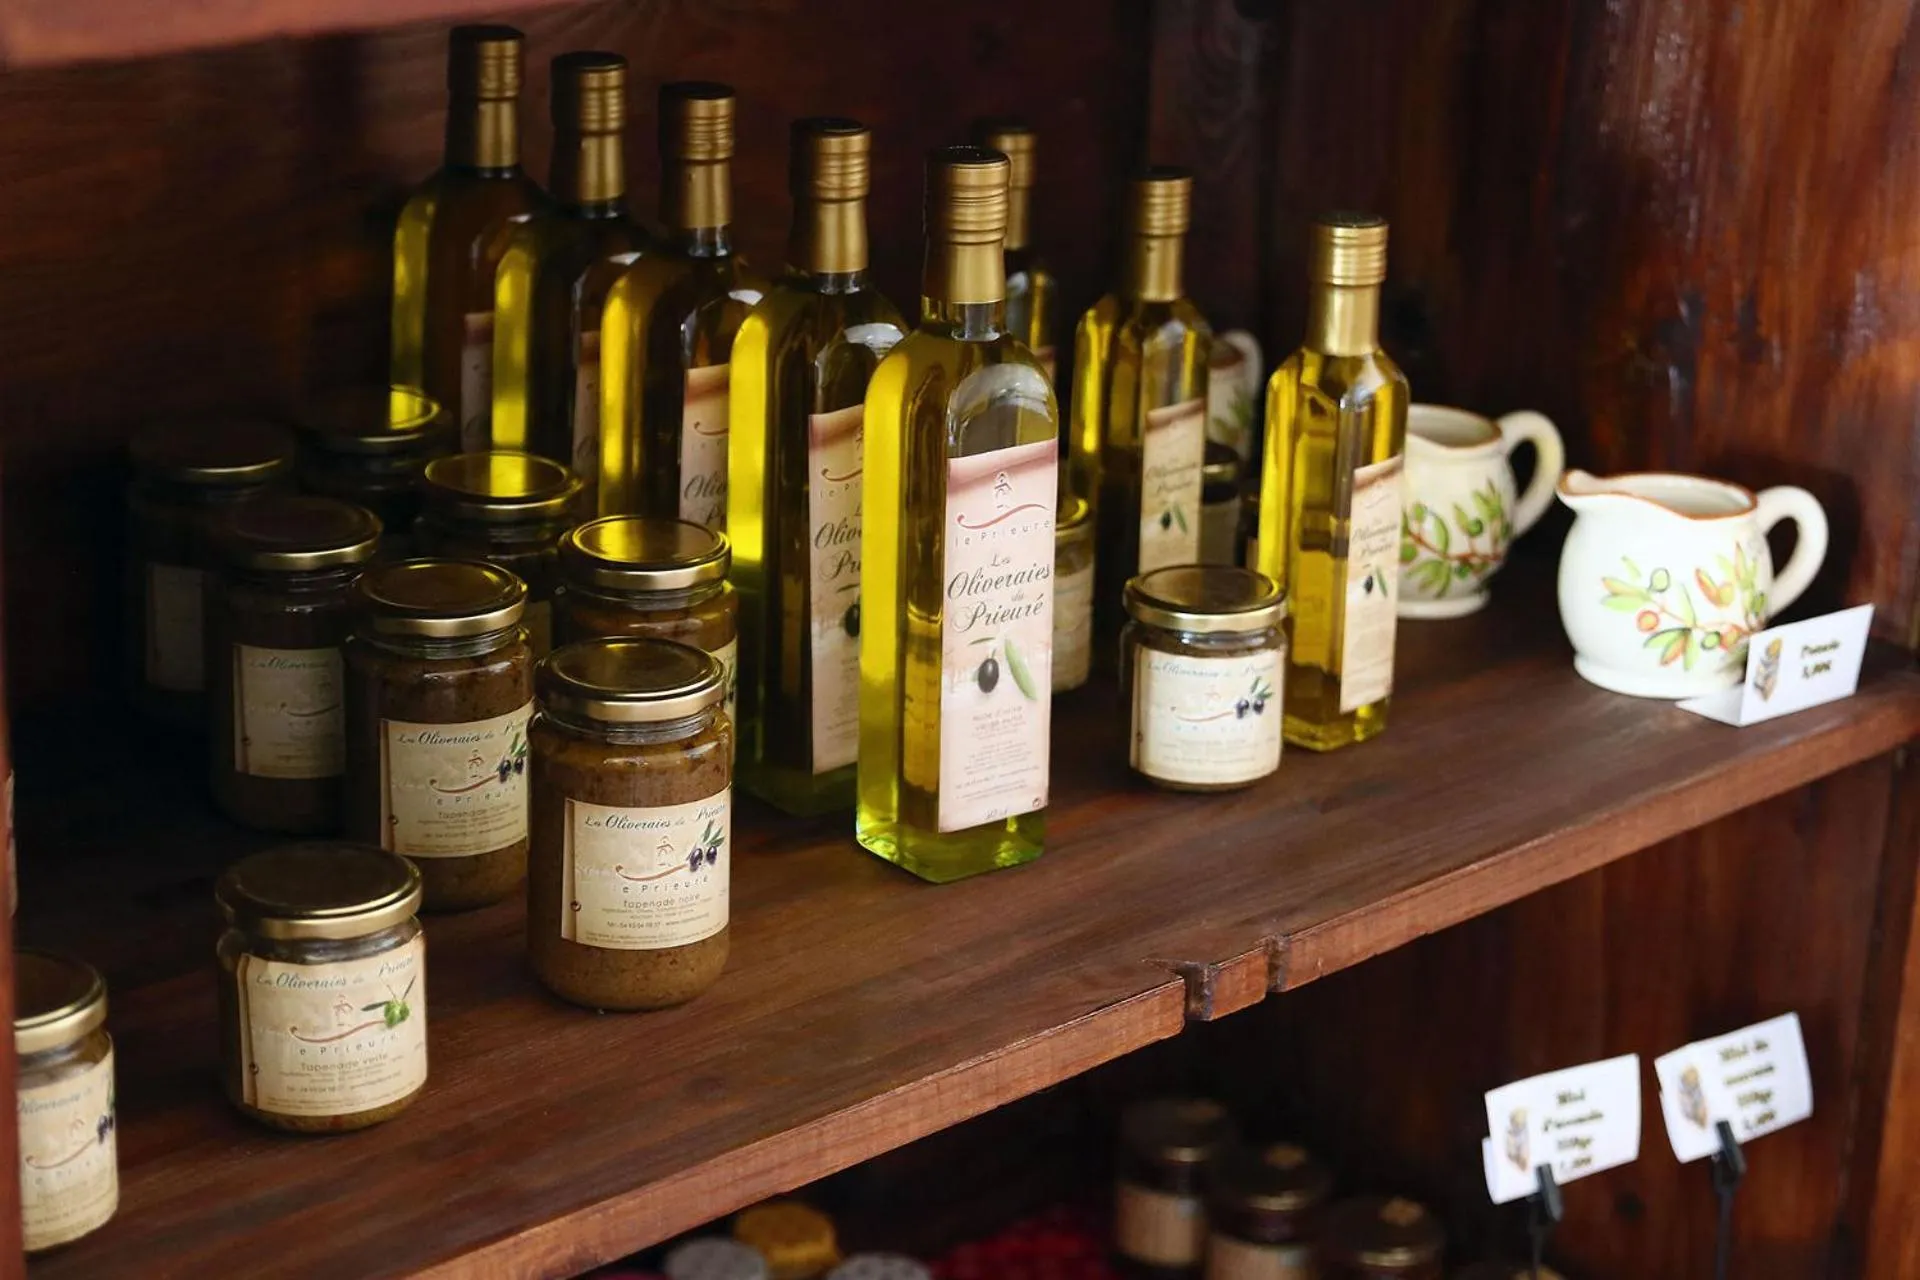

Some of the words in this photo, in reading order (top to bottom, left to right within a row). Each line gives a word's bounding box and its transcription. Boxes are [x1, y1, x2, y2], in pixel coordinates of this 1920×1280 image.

[946, 563, 1051, 600] Oliveraies
[953, 593, 1045, 634] Prieuré
[605, 813, 671, 830] Oliveraies
[276, 971, 347, 989] Oliveraies
